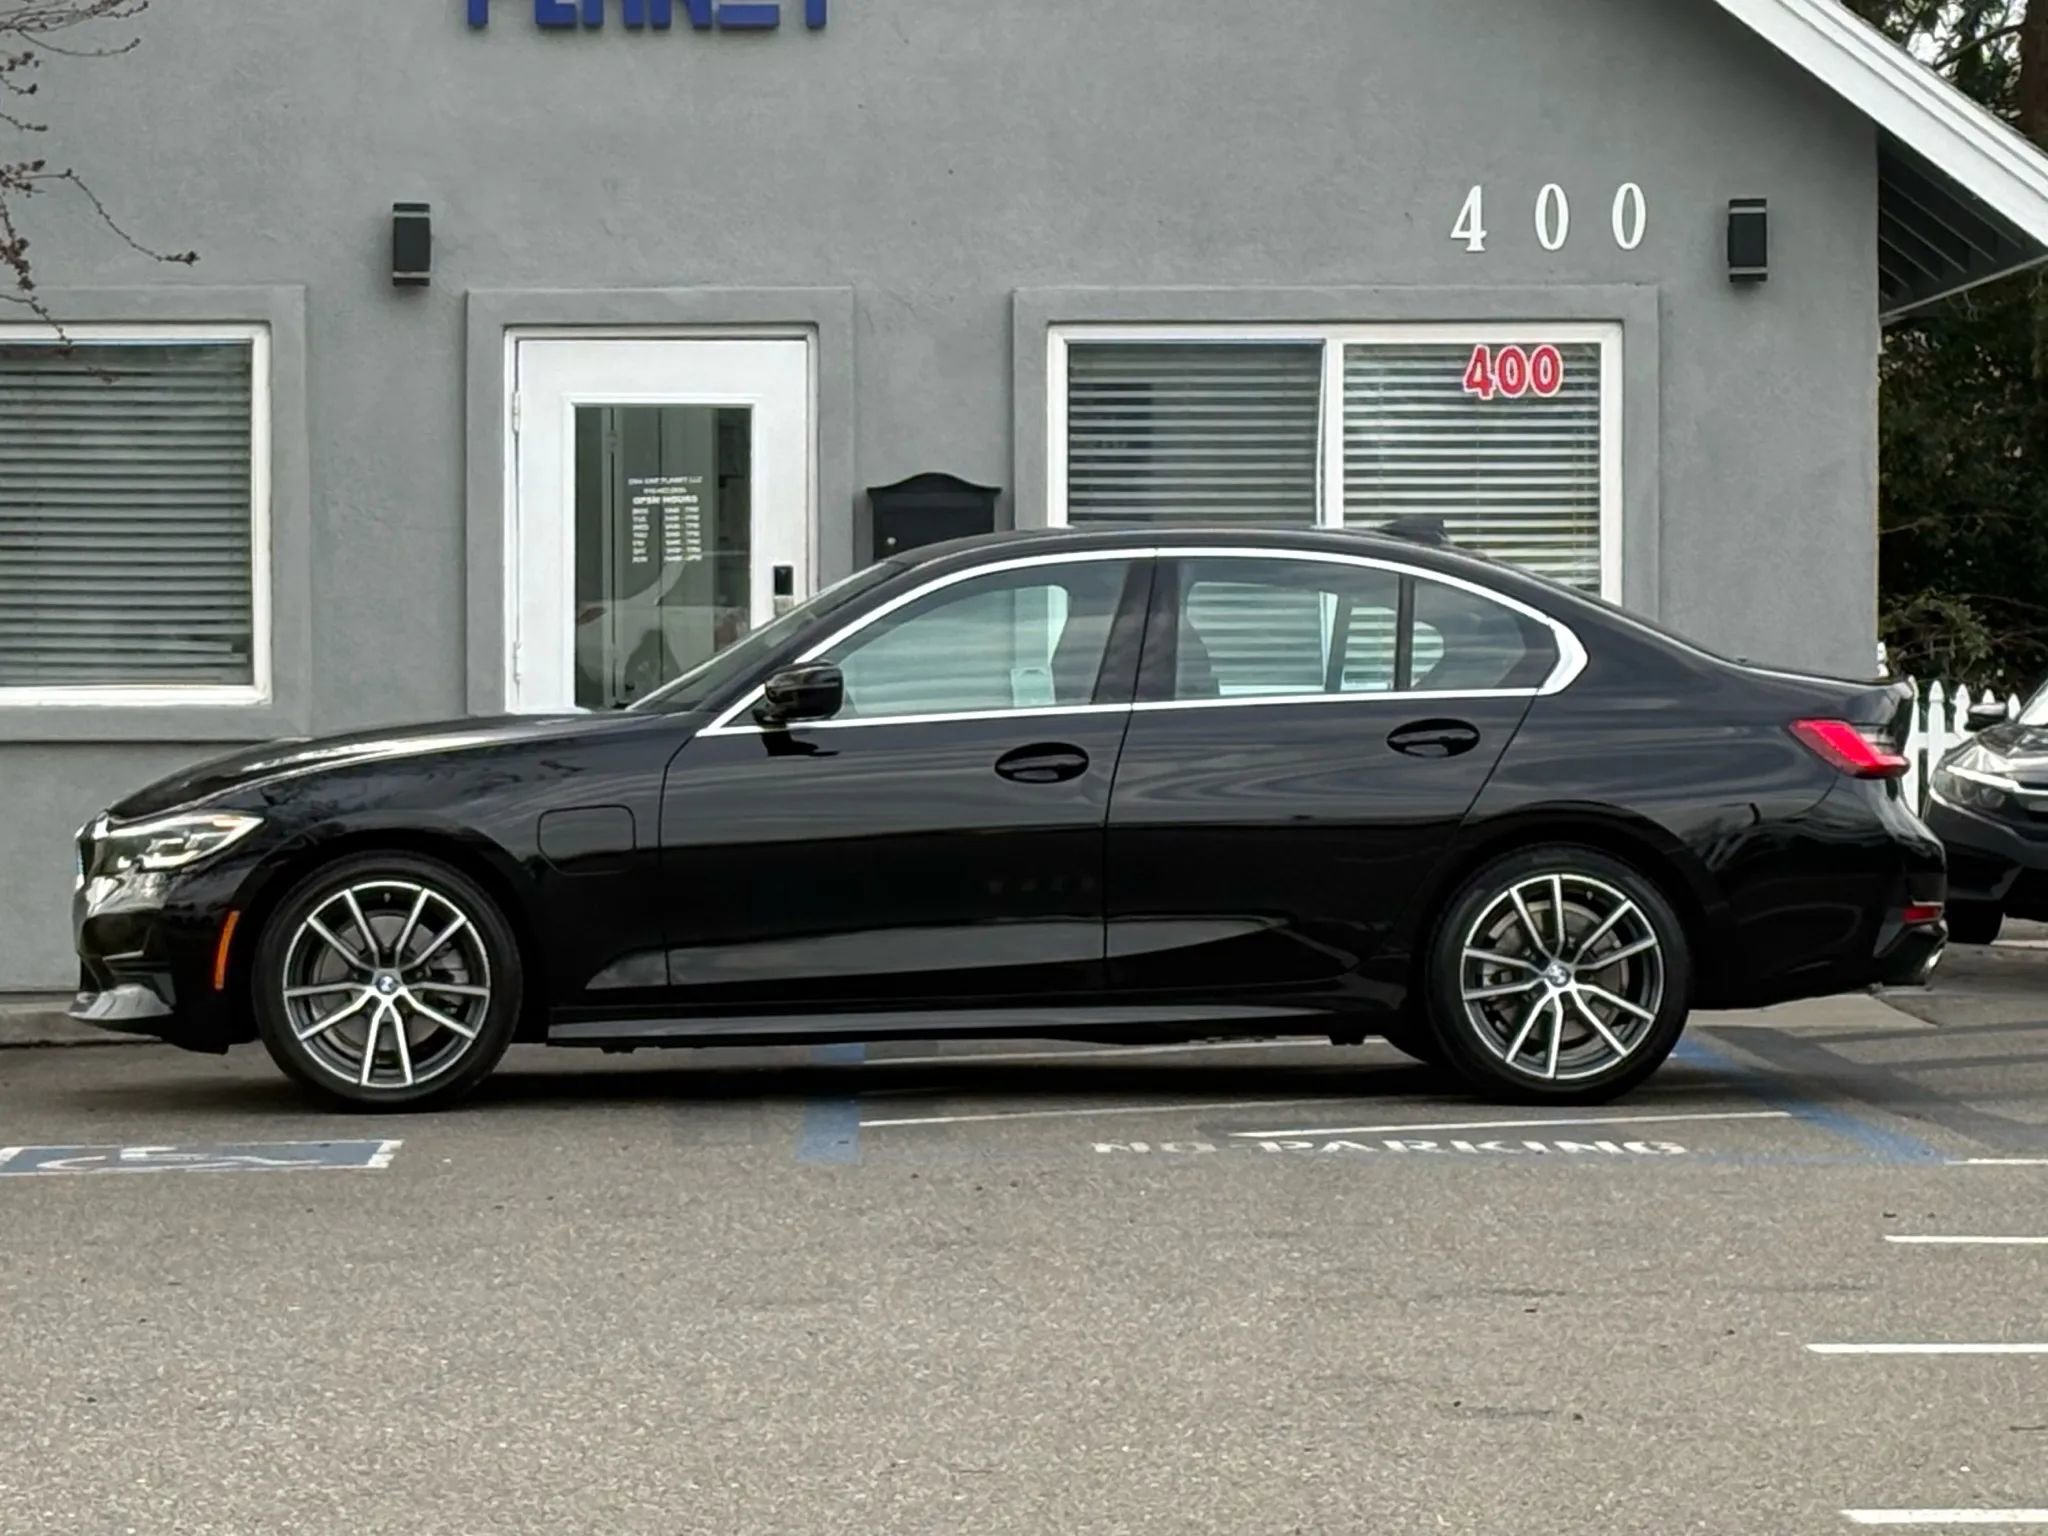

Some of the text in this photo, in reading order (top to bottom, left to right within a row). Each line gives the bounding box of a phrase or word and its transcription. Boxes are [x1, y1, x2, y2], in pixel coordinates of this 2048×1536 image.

[1463, 344, 1564, 399] 400
[1091, 1139, 1687, 1155] NO PARKING
